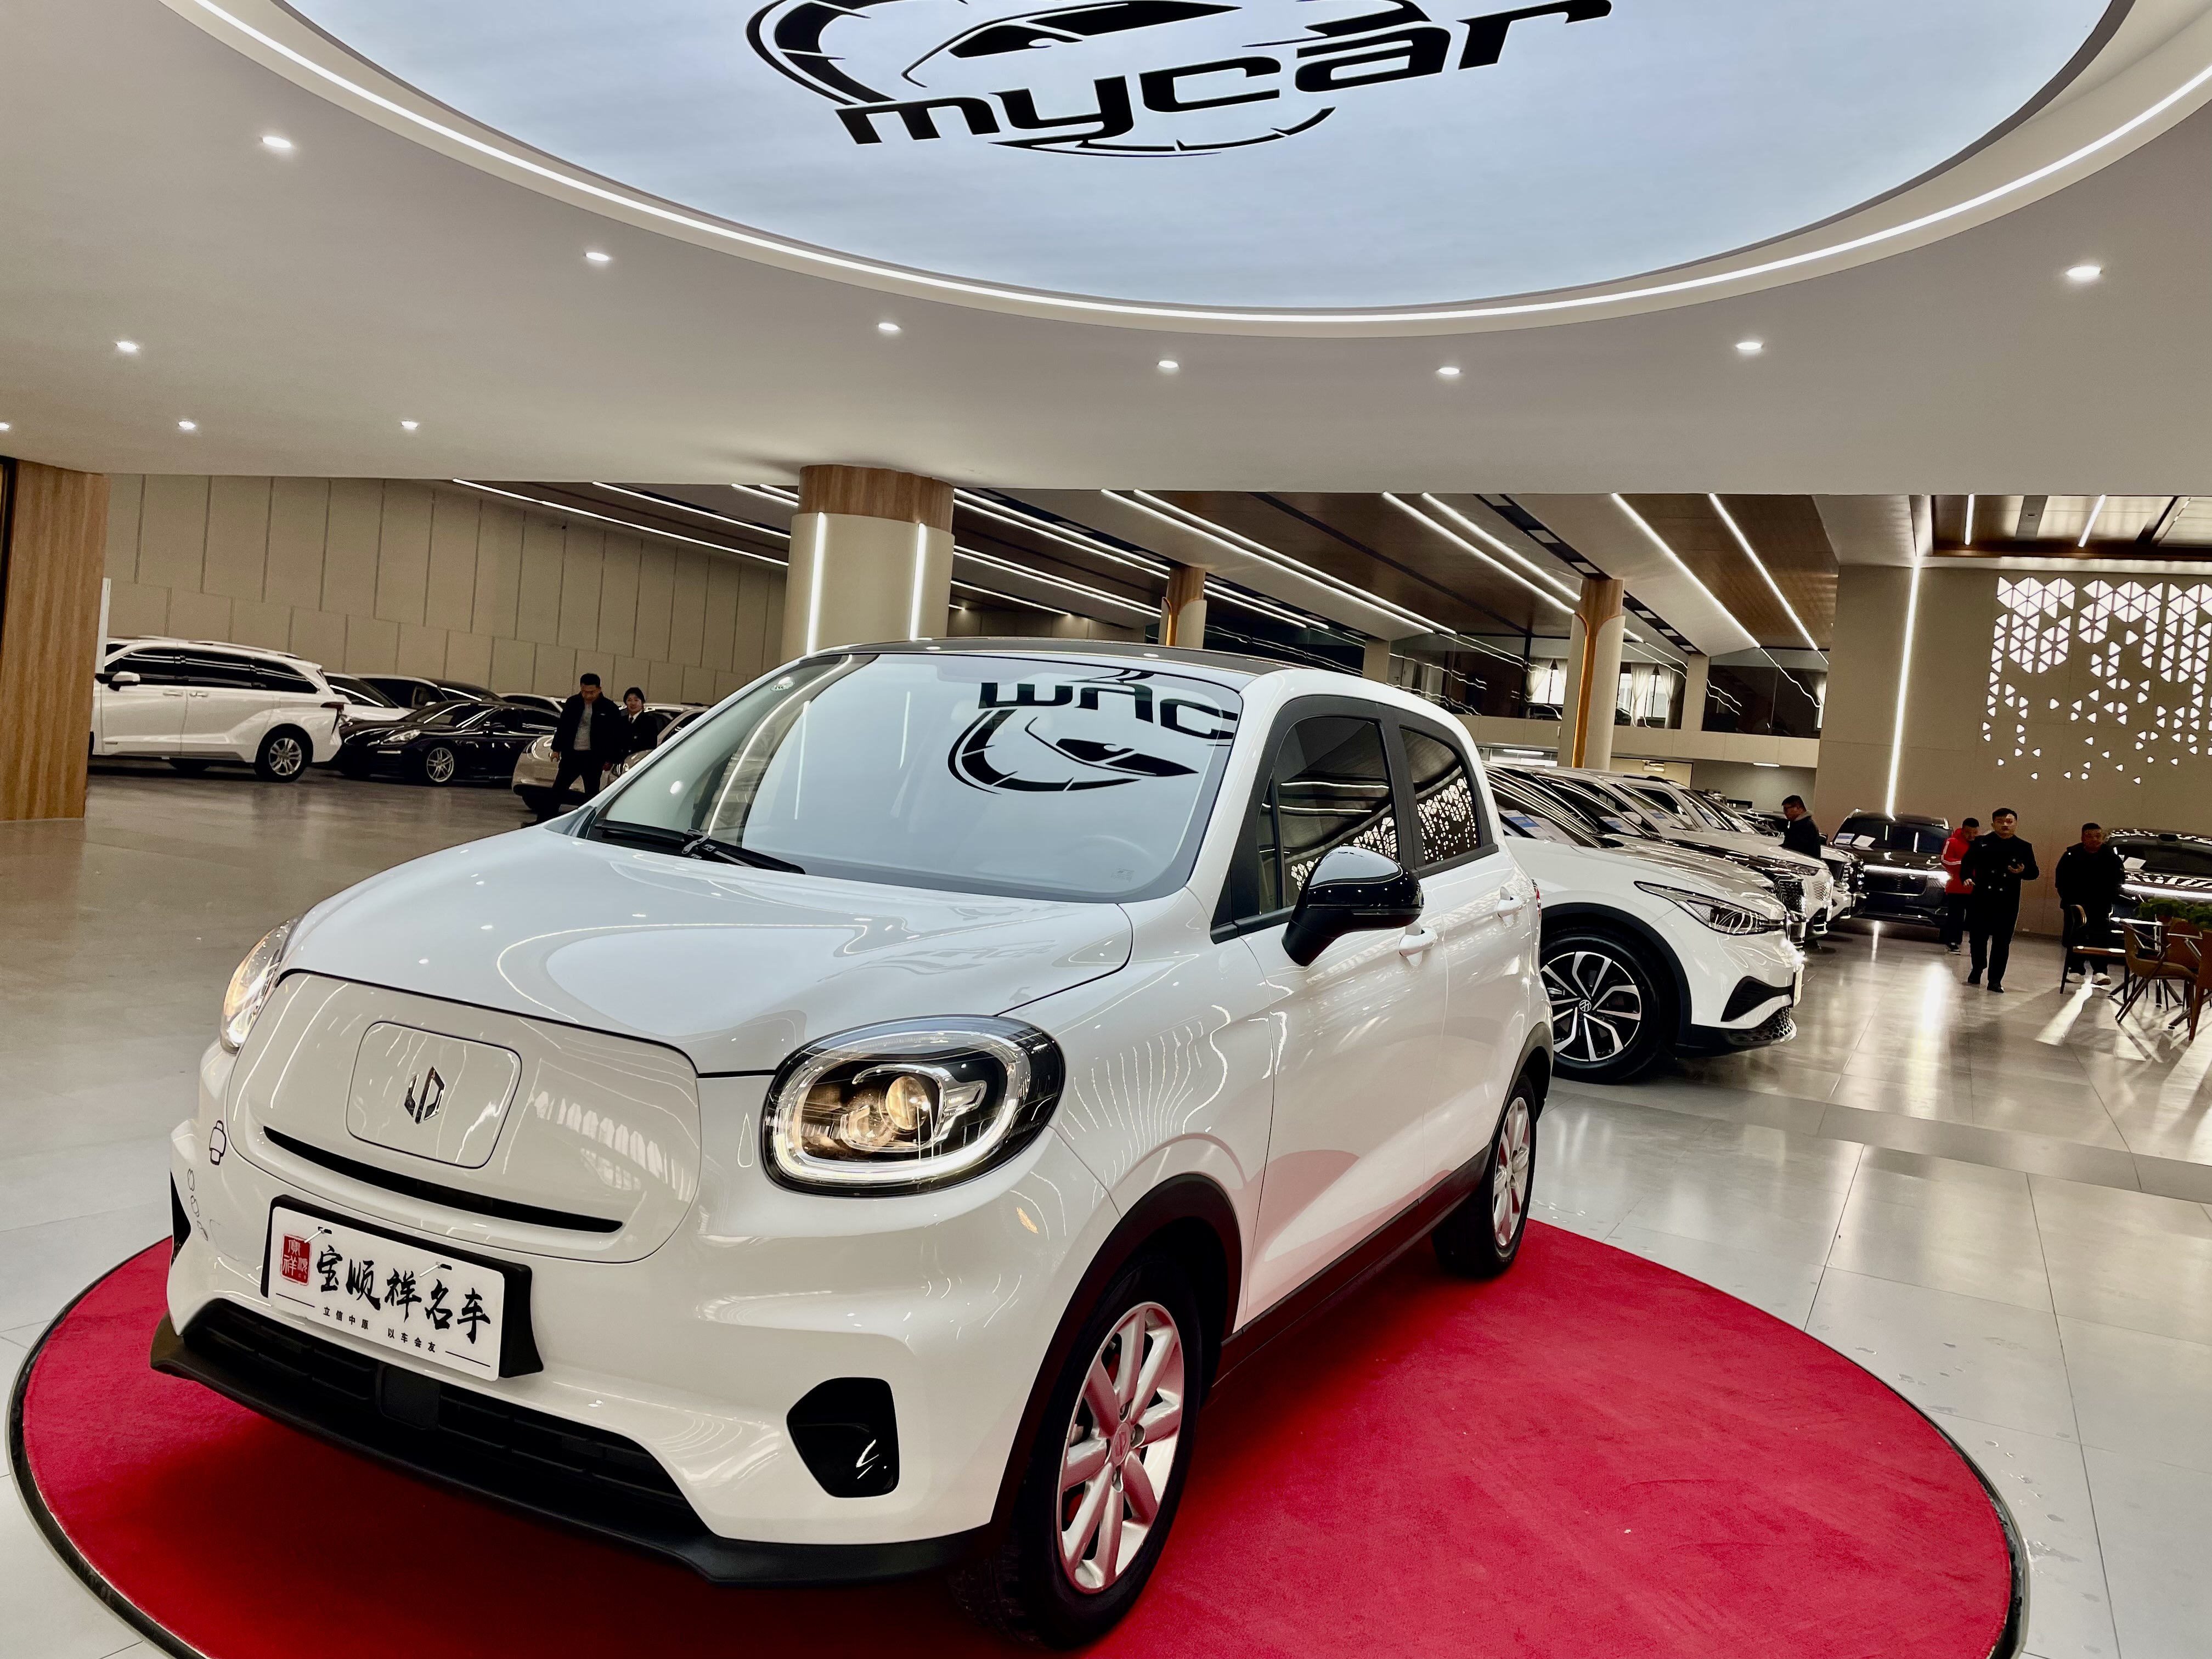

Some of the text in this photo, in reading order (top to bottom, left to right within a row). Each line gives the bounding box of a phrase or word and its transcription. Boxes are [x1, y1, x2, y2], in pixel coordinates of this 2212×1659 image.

[834, 0, 1612, 145] mycar
[317, 1245, 490, 1344] 宝顺祥名车
[323, 1306, 435, 1353] 立信中原 以车会友
